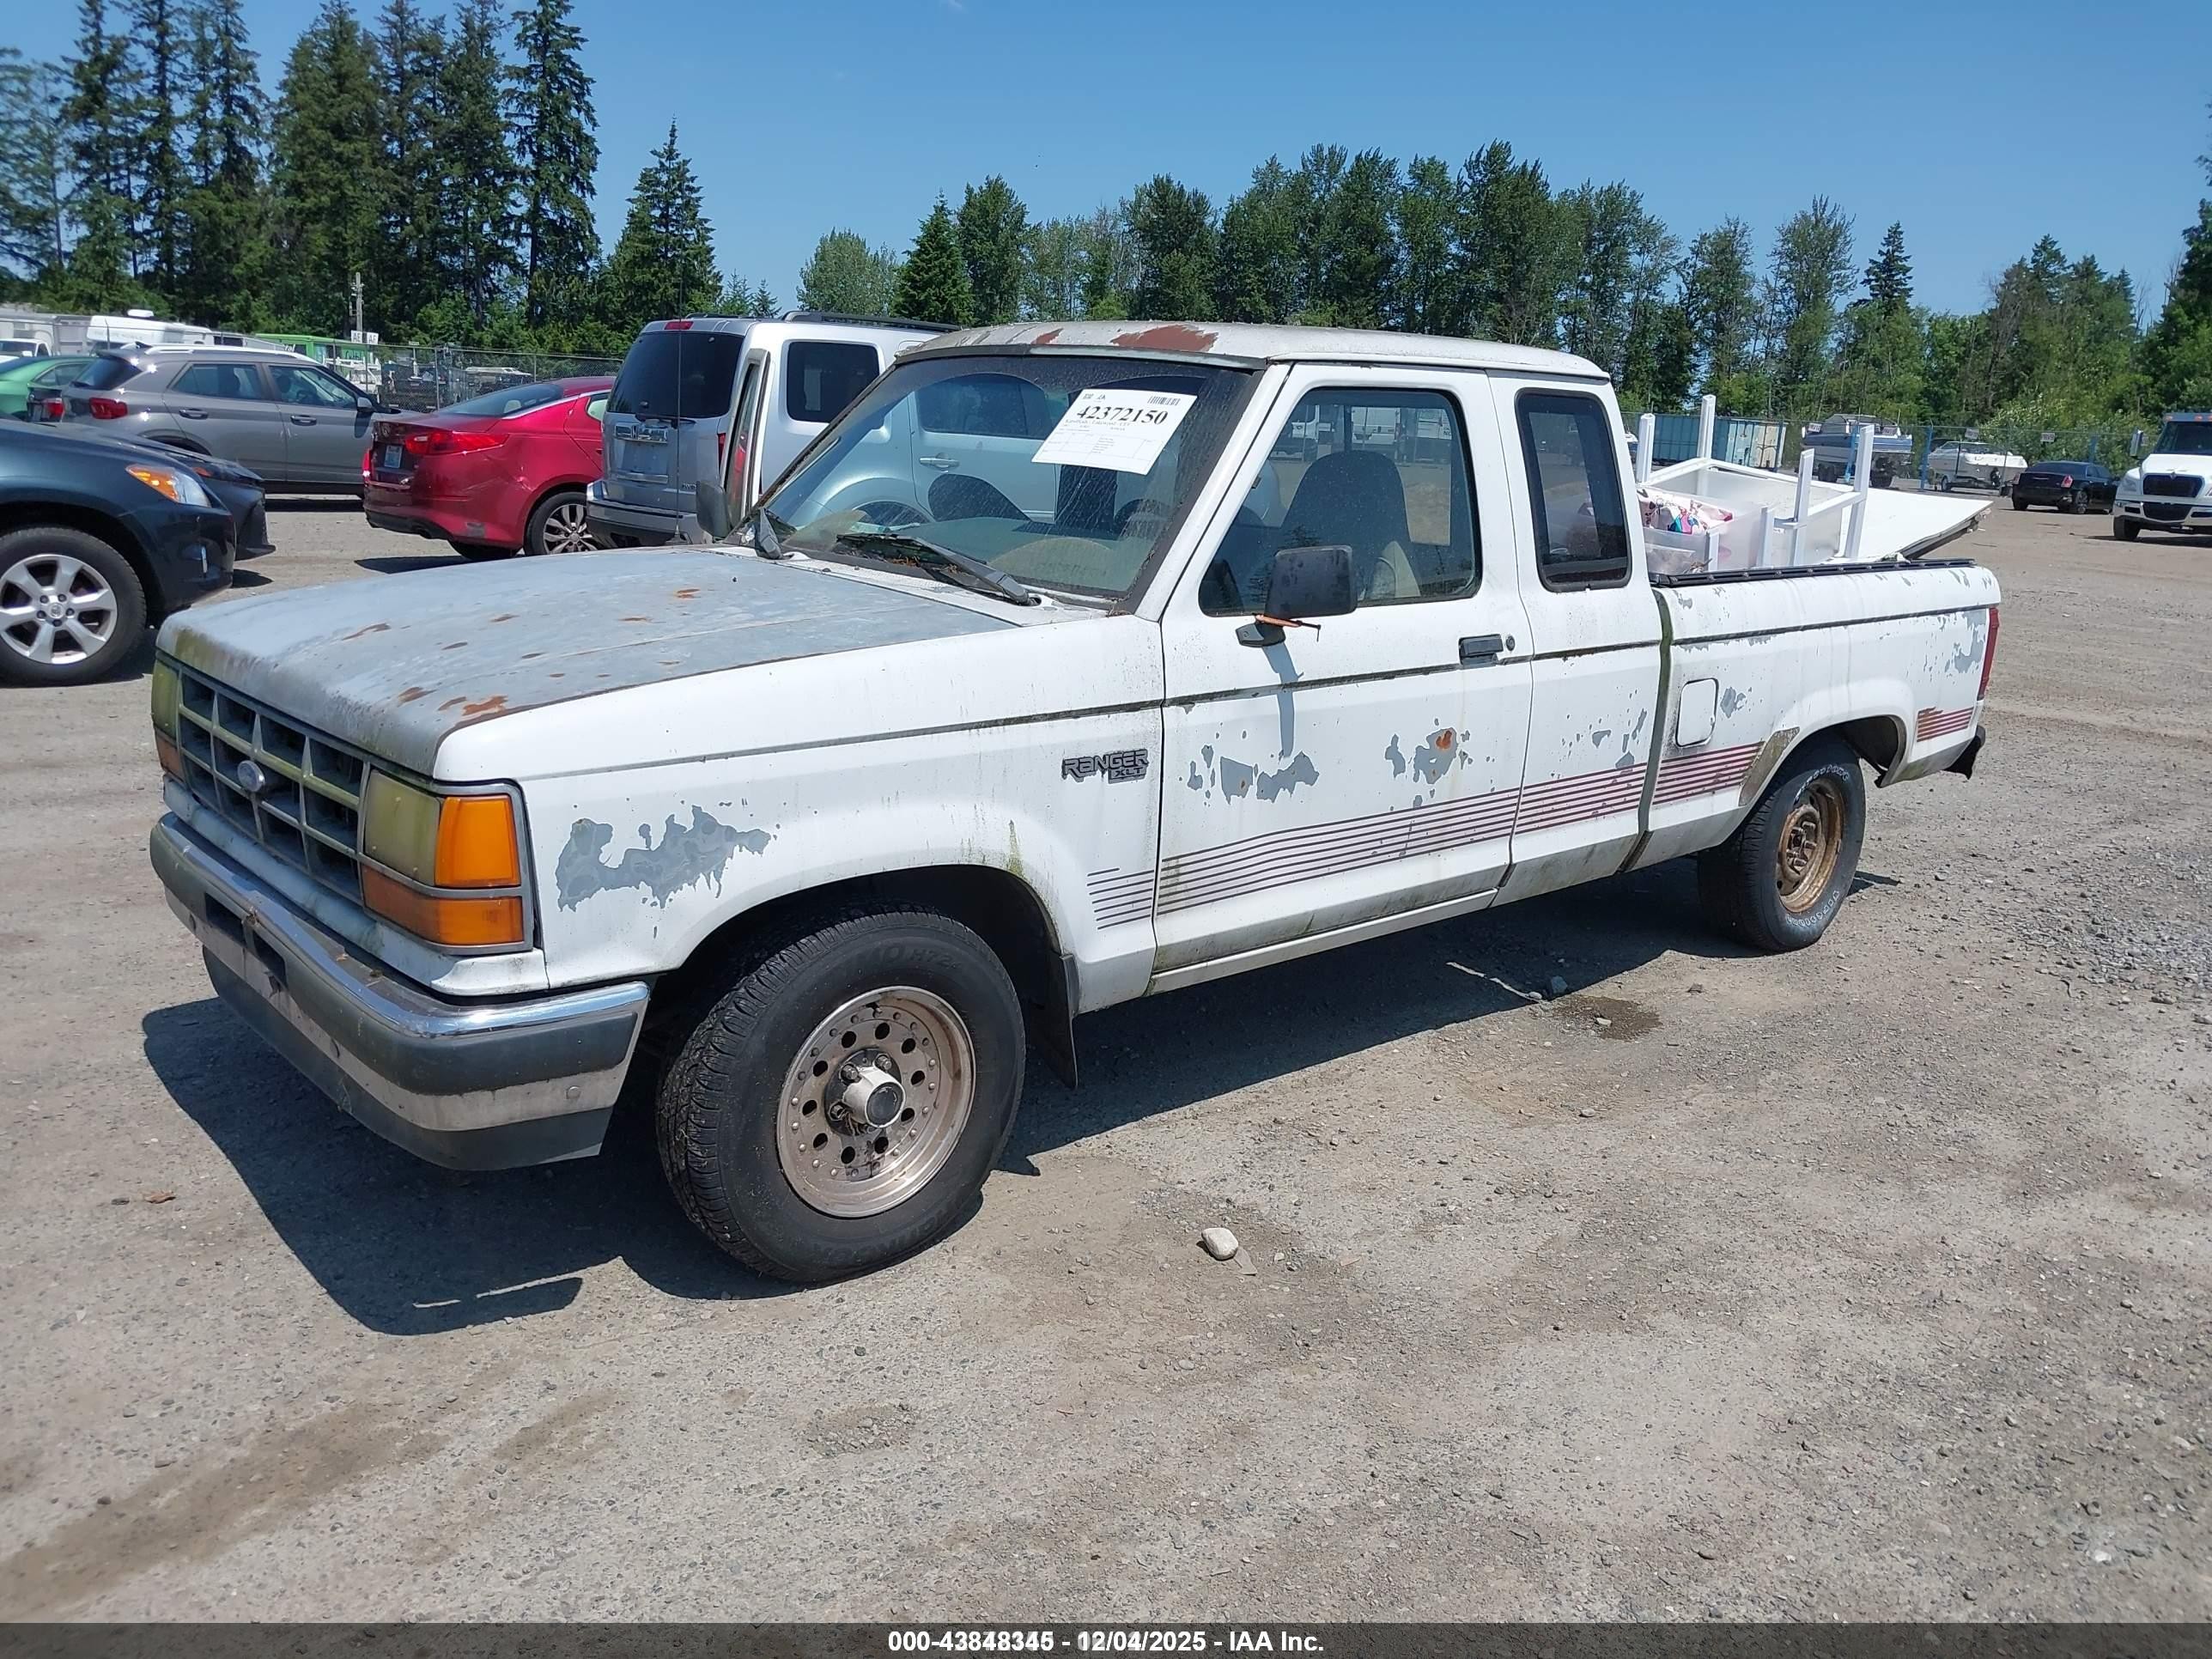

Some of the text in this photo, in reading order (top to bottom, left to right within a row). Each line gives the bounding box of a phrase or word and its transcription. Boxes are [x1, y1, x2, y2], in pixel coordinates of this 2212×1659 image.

[1077, 405, 1169, 425] 42372150
[1062, 748, 1149, 781] RANGER
[1114, 766, 1144, 778] XLT
